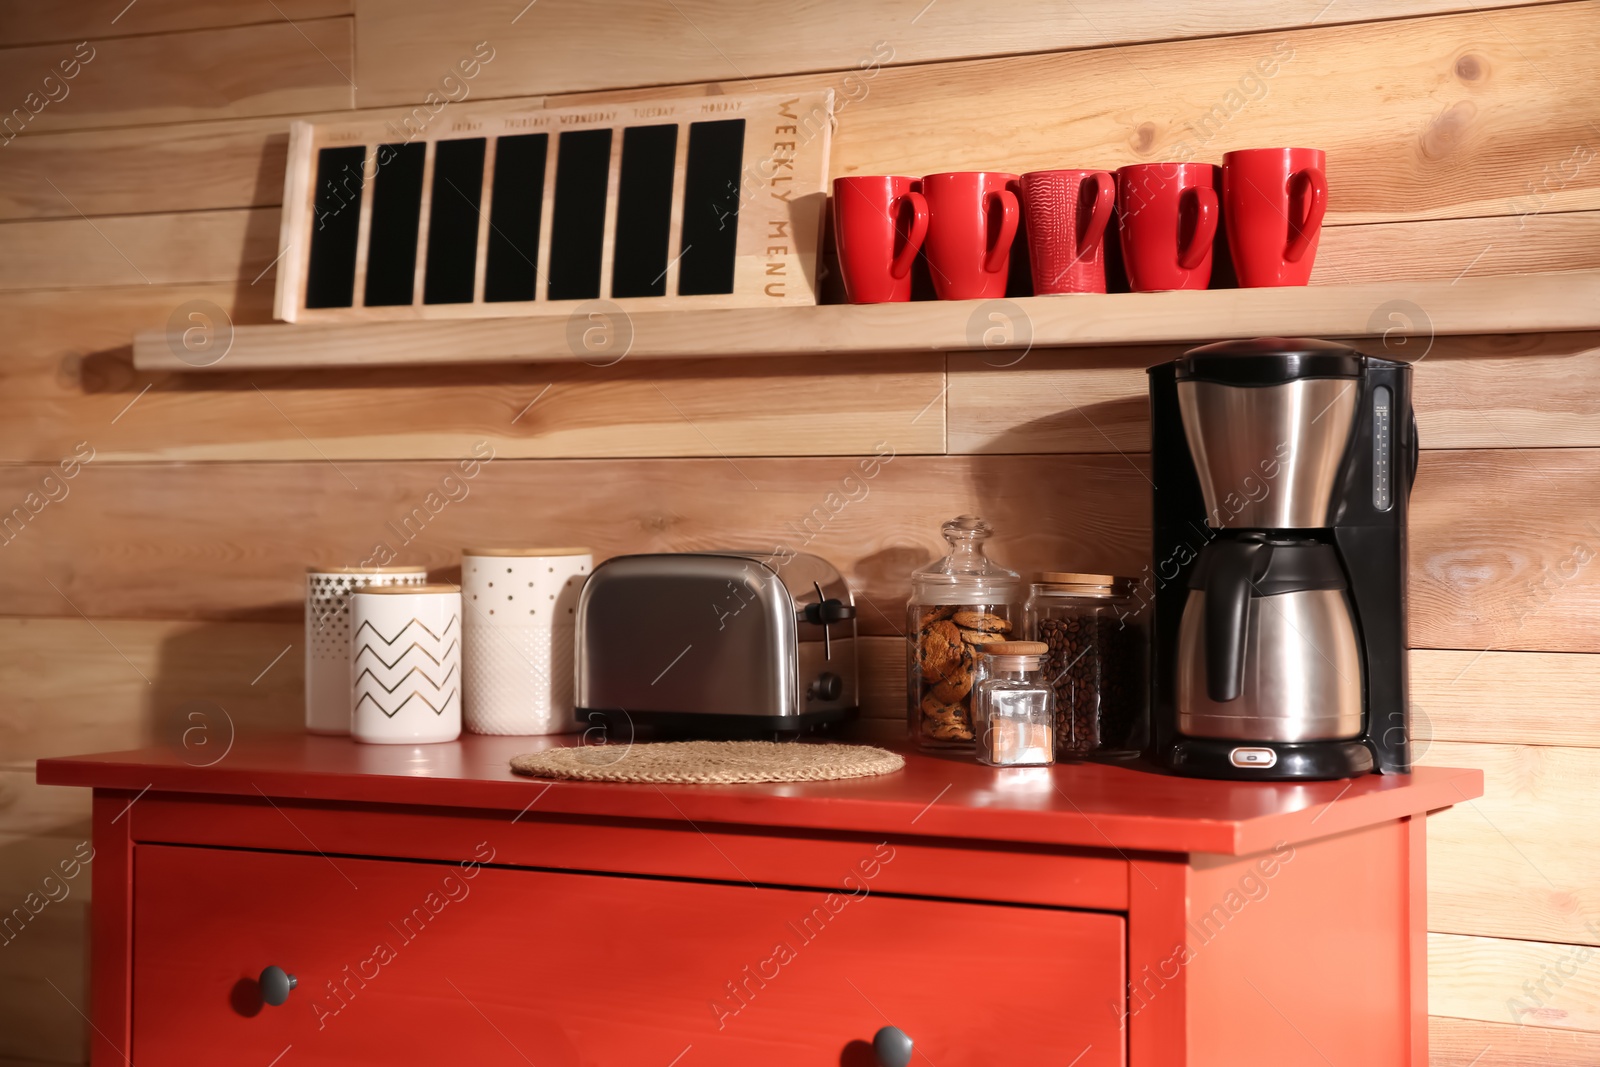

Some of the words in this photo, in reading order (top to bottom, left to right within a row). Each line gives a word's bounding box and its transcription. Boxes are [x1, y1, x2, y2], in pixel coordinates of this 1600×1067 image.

[633, 106, 676, 119] TUESDAY
[701, 101, 743, 114] MONDAY
[504, 116, 551, 129] THURSDAY
[560, 111, 617, 125] WEDNESDAY
[386, 125, 428, 137] SARDAY
[771, 97, 800, 204] WEEKLY
[764, 221, 789, 297] MENU
